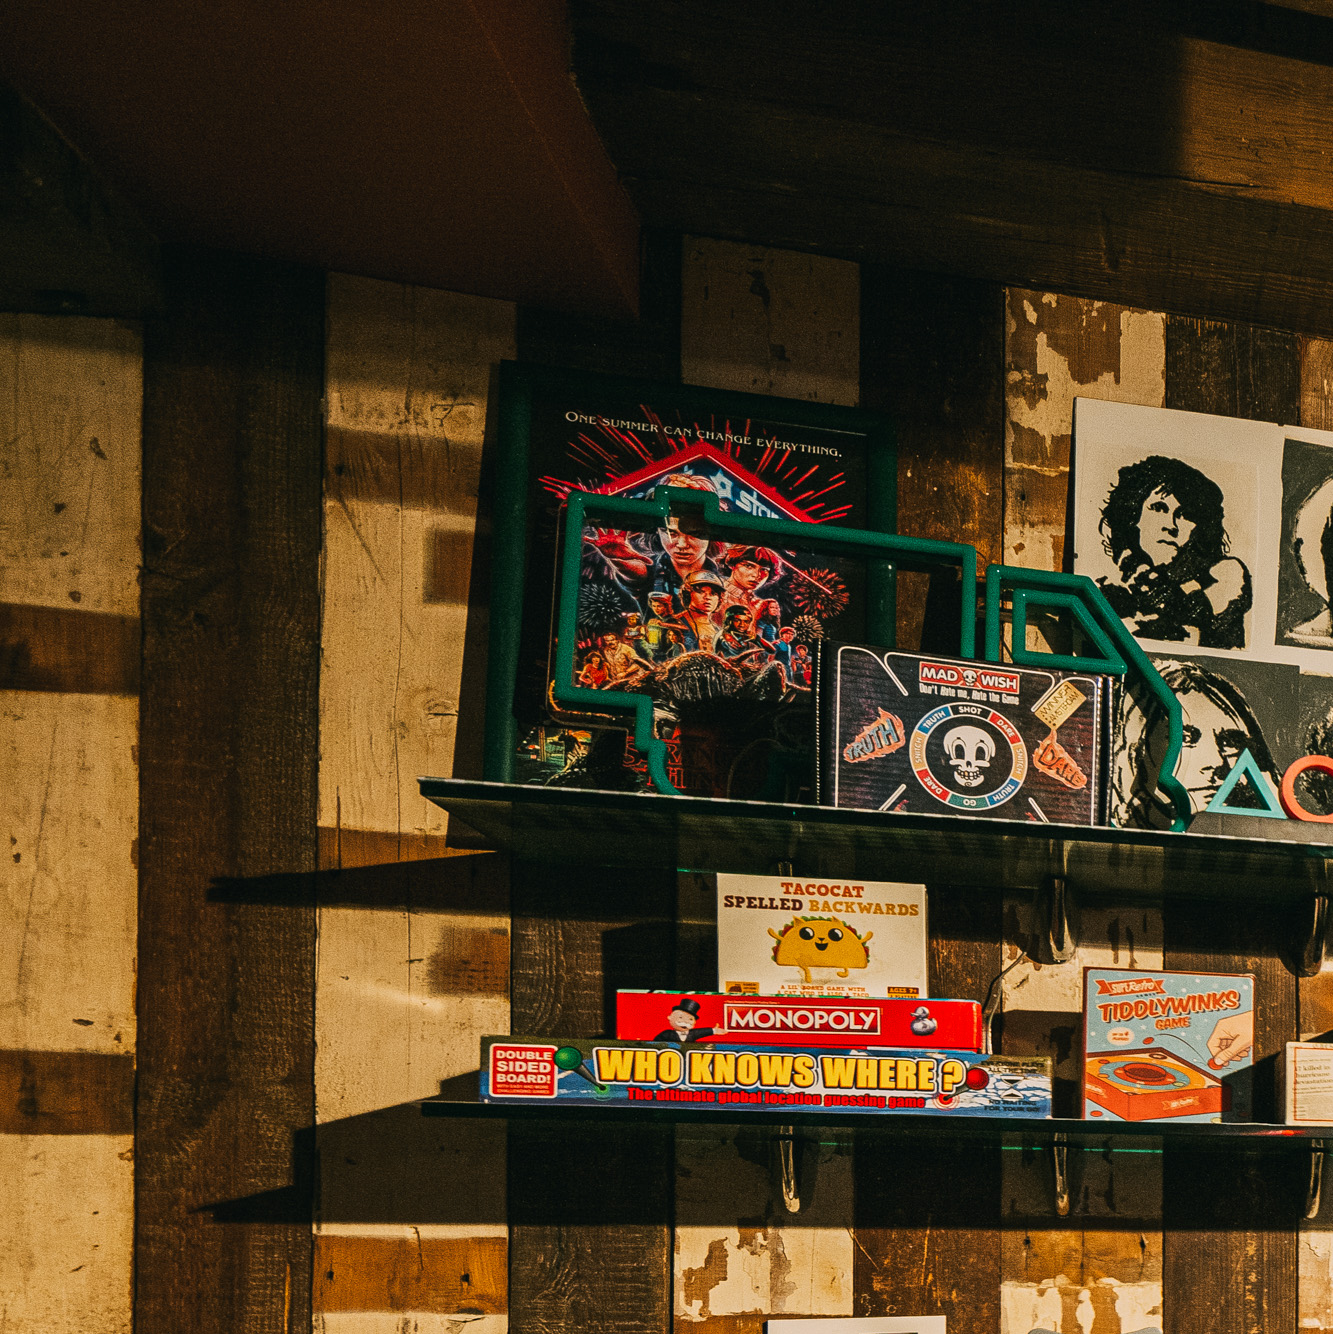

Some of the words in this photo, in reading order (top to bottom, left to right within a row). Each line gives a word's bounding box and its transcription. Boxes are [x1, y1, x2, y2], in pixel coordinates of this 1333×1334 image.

[565, 411, 597, 425] ONE
[602, 417, 658, 433] SUMMER
[664, 425, 692, 437] CAN
[697, 430, 751, 445] CHANGE
[922, 667, 958, 682] MAD
[981, 676, 1018, 689] WISH
[923, 711, 946, 729] TRUTH
[958, 705, 983, 716] SHOT
[996, 719, 1016, 739] DARE
[845, 718, 900, 761] TRUTH
[915, 737, 923, 764] SNITCH
[924, 776, 944, 795] DARE
[992, 782, 1015, 802] TRUTH
[963, 798, 977, 807] GO
[780, 882, 865, 898] TACOCAT
[723, 895, 804, 912] SPELLED
[808, 899, 920, 917] BACKWARDS
[1098, 989, 1241, 1024] TIDDLYWINKS
[730, 1008, 876, 1030] MONOPOLY
[1154, 1015, 1191, 1031] GAME
[496, 1050, 552, 1060] DOUBLE
[496, 1061, 551, 1073] SIDED
[597, 1050, 681, 1083] WHO
[691, 1052, 814, 1088] KNOWS
[822, 1058, 934, 1092] WHERE
[496, 1073, 551, 1084] BOARD!
[627, 1087, 650, 1100] The
[656, 1088, 715, 1103] ultimate
[718, 1091, 763, 1105] global
[765, 1092, 821, 1106] location
[824, 1094, 886, 1109] guessing
[888, 1097, 925, 1109] game
